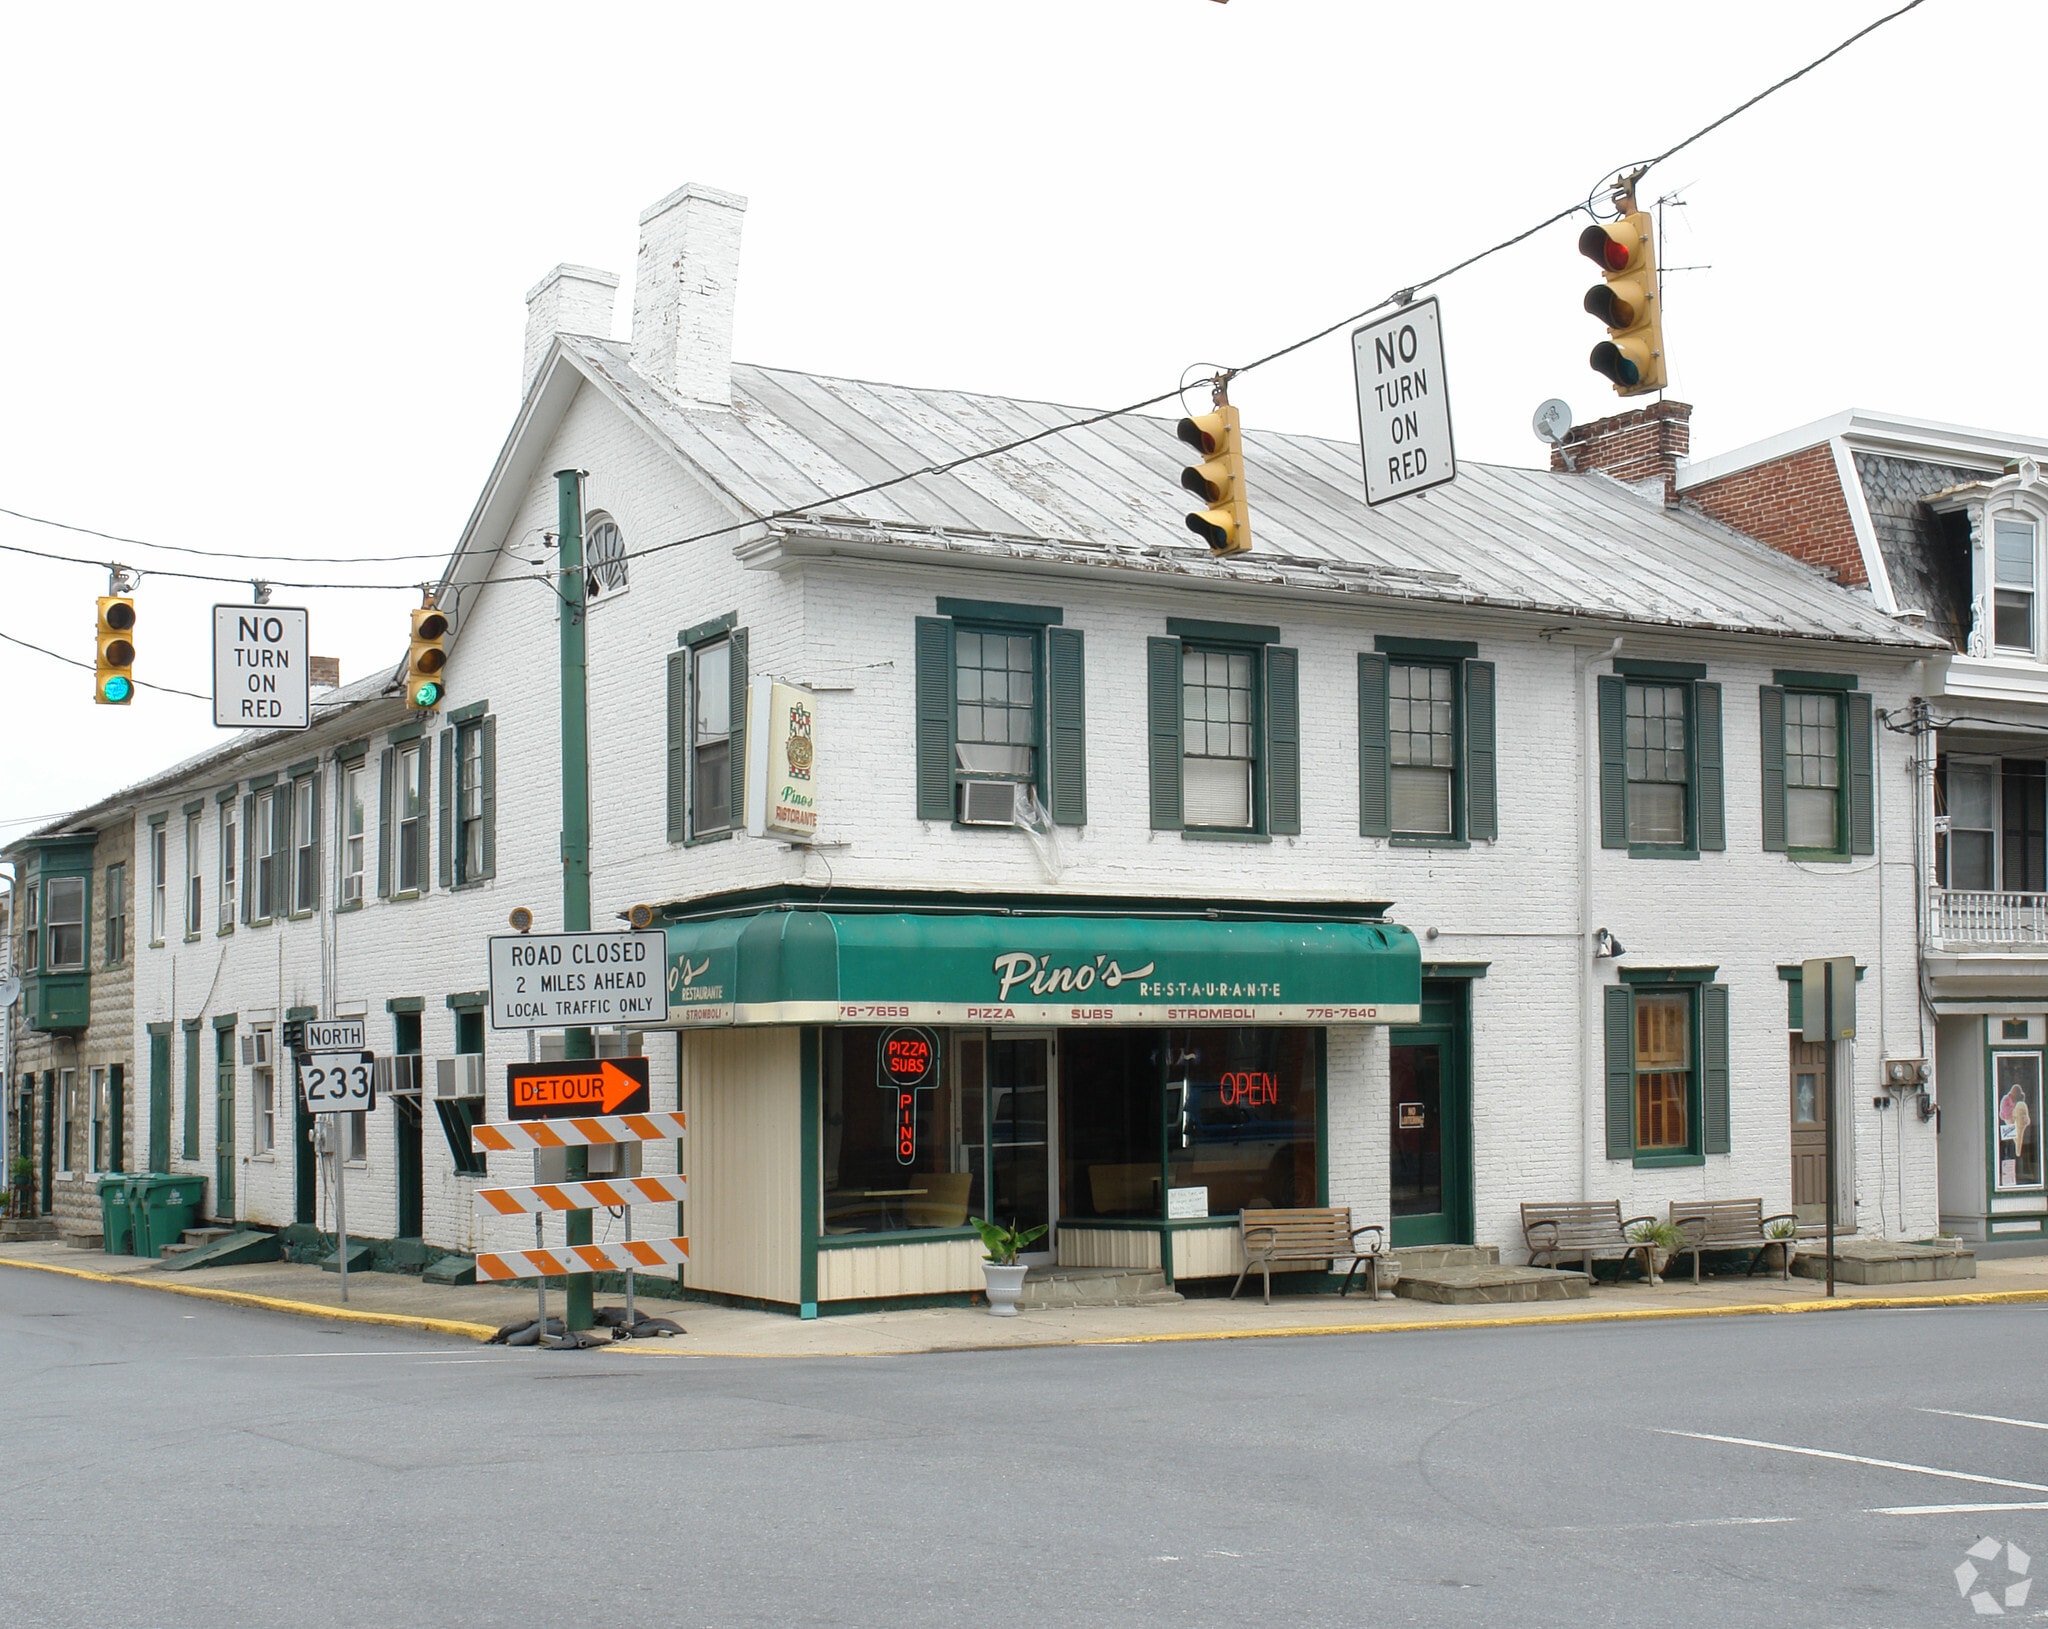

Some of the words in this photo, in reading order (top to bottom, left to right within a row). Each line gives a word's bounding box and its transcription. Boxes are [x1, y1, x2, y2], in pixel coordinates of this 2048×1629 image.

[1374, 324, 1417, 374] NO
[1374, 368, 1428, 412] TURN
[1391, 410, 1418, 444] ON
[1388, 447, 1427, 484] RED
[238, 616, 283, 643] NO
[234, 648, 289, 668] TURN
[248, 673, 275, 693] ON
[241, 699, 282, 718] RED
[512, 945, 562, 967] ROAD
[572, 942, 646, 964] CLOSED
[516, 976, 526, 993] 2
[541, 973, 585, 993] MILES
[594, 972, 646, 990] AHEAD
[993, 952, 1156, 1002] Pino's
[682, 985, 723, 1001] RESTAURANTE
[507, 1002, 548, 1018] LOCAL
[556, 999, 611, 1015] TRAFFIC
[619, 997, 653, 1012] ONLY
[686, 1008, 722, 1020] STROMBOLI
[968, 1008, 1015, 1019] PIZZA
[1071, 1009, 1113, 1019] SUBS
[1168, 1009, 1256, 1019] STROMBOLI
[1306, 1008, 1377, 1018] 776-7640
[310, 1027, 361, 1046] NORTH
[888, 1041, 928, 1057] PIZZA
[890, 1057, 925, 1073] SUBS
[308, 1066, 369, 1100] 233
[521, 1078, 604, 1101] DETOUR
[1220, 1072, 1278, 1106] OPEN
[900, 1094, 913, 1156] PINO
